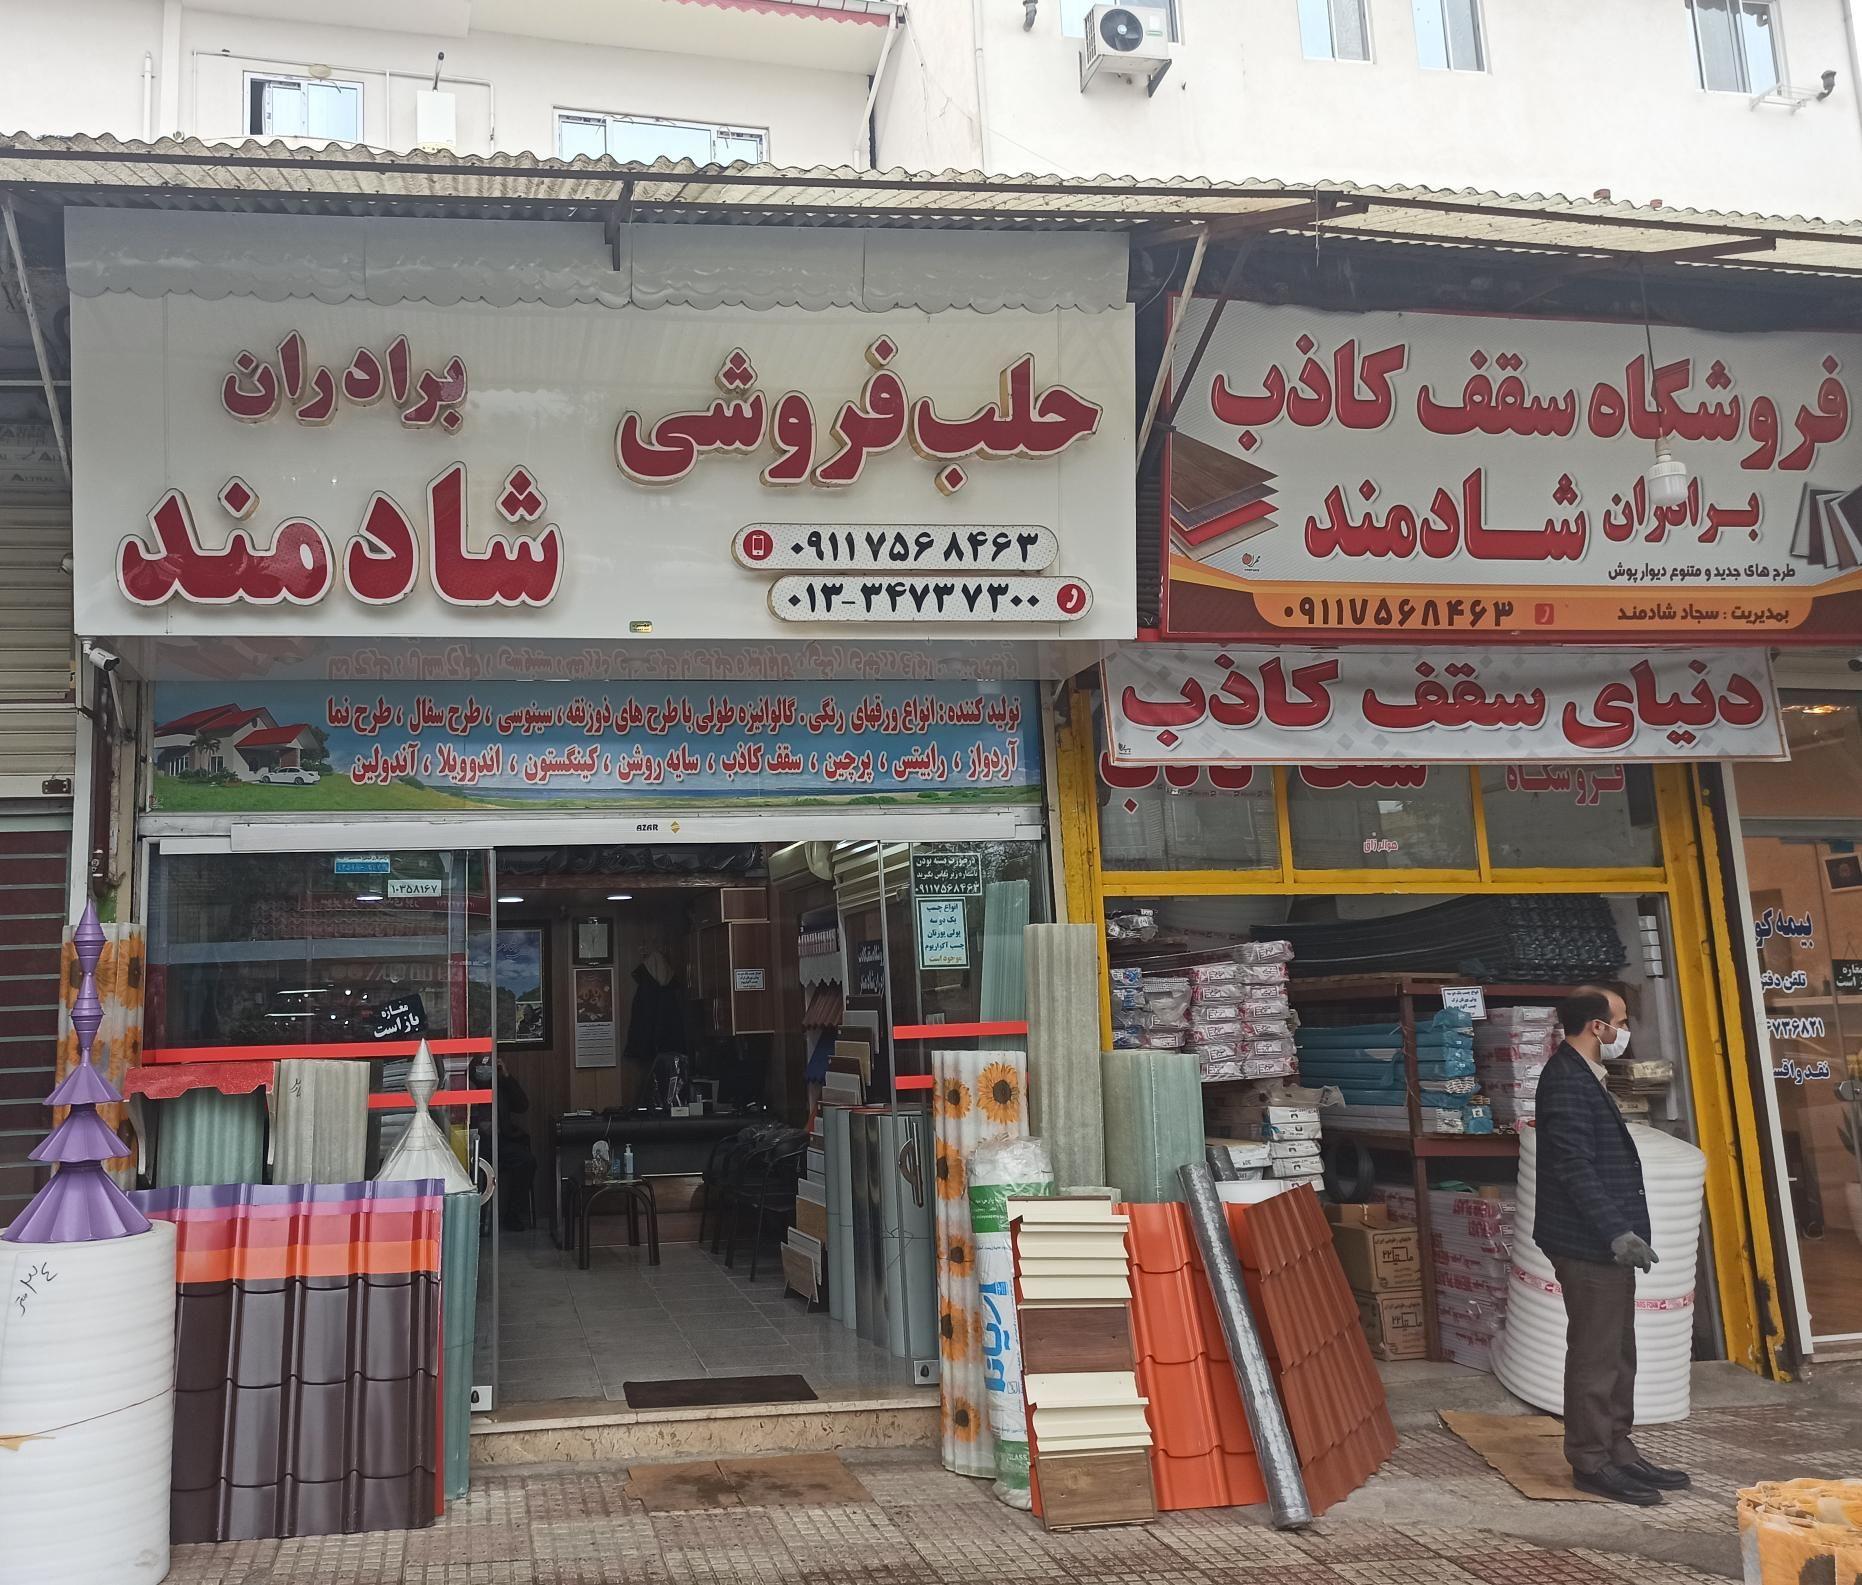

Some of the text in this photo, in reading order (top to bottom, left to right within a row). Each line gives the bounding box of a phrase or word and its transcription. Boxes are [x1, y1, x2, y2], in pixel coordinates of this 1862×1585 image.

[222, 329, 468, 434] برادران
[615, 335, 1103, 495] حلب فروشی
[1210, 333, 1849, 472] فروشگاه سقف کاذب
[1303, 466, 1587, 563] شادمند
[115, 461, 565, 607] شادمند
[1670, 565, 1701, 581] متنوع
[1705, 568, 1711, 581] و
[1714, 566, 1741, 581] جدید
[1744, 564, 1769, 578] های
[1773, 564, 1795, 581] طرح
[1284, 597, 1513, 628] ۰۹۱۱۷۵۶۸۴۶۳
[1618, 603, 1676, 620] شادمند
[1681, 604, 1719, 623] سجاد
[1731, 606, 1790, 624] بمدیریت
[327, 696, 349, 726] نما
[354, 697, 391, 733] طرح
[410, 697, 444, 732] سفال
[448, 697, 480, 733] طرح
[498, 702, 552, 733] سینوسی
[566, 696, 611, 733] ذوزنقه
[615, 697, 643, 732] های
[646, 697, 678, 733] طرح
[682, 697, 692, 731] با
[696, 697, 734, 732] طولی
[739, 697, 795, 733] گالوانیزه
[851, 695, 898, 732] ورقهای
[901, 695, 935, 731] انواع
[987, 695, 1020, 731] تولید
[1122, 655, 1764, 749] دنیای سقف کاذب
[353, 743, 419, 783] آندولین
[525, 747, 598, 782] کینگستون
[619, 746, 663, 781] روشن
[667, 744, 699, 779] سایه
[721, 744, 762, 779] کاذب
[767, 745, 801, 772] سقف
[825, 751, 872, 782] پرچین
[969, 740, 1017, 779] آردواز
[1775, 909, 1814, 948] بیمه
[1783, 970, 1807, 993] تلفن
[1843, 963, 1862, 976] غازه
[374, 1013, 420, 1038] باز است
[381, 1001, 408, 1019] مغازه
